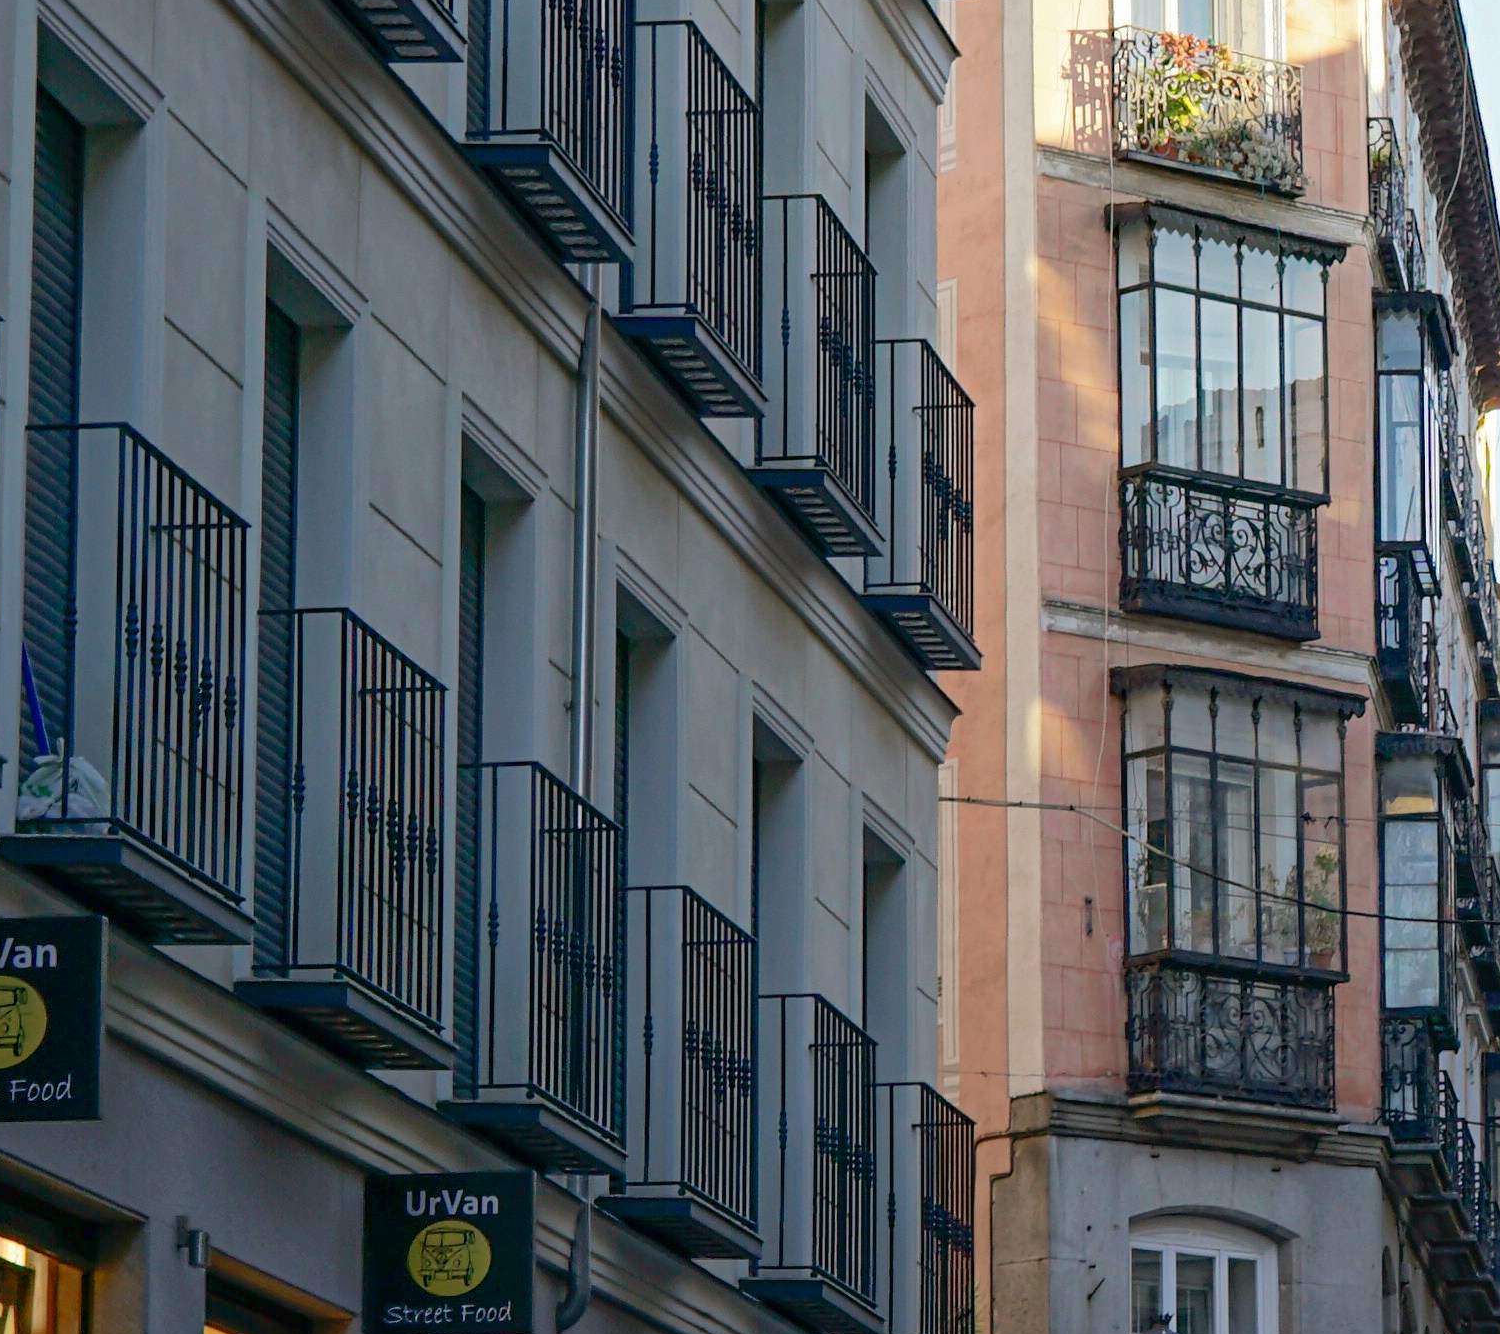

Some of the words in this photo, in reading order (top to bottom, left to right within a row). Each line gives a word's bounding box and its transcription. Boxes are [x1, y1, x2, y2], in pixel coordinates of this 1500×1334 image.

[9, 1074, 72, 1101] Food
[406, 1189, 499, 1217] UrVan
[385, 1303, 453, 1324] Street
[461, 1300, 512, 1323] Food
